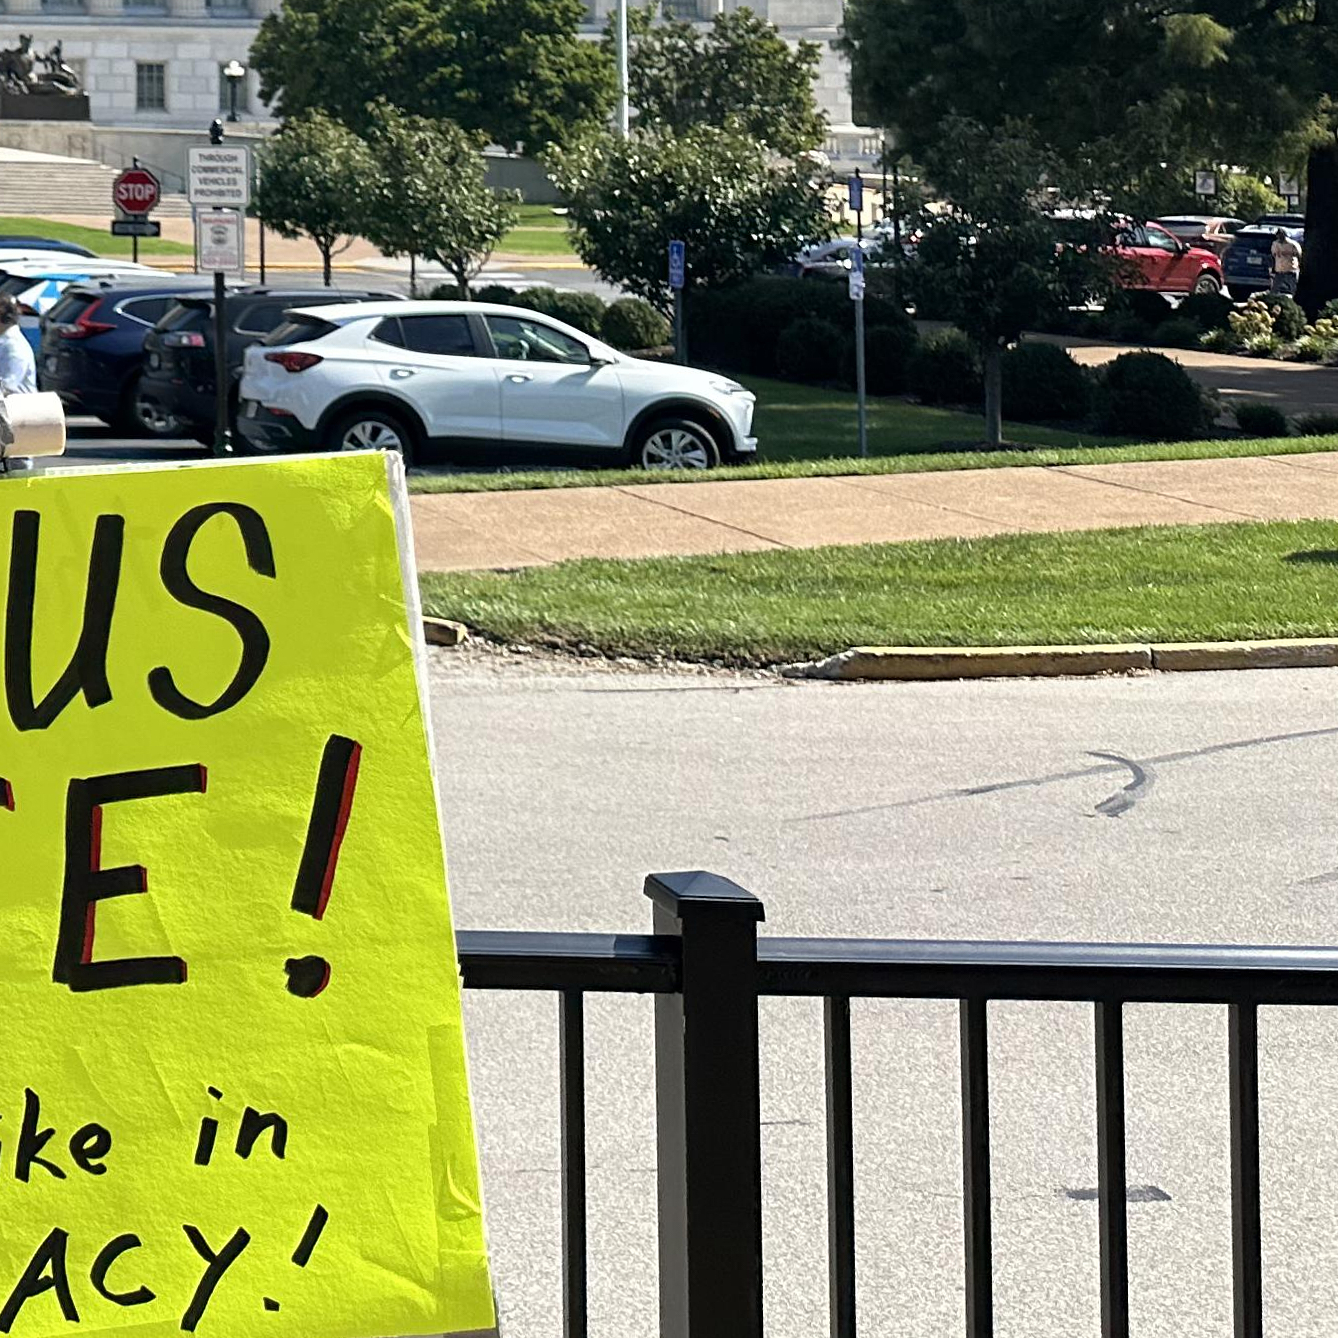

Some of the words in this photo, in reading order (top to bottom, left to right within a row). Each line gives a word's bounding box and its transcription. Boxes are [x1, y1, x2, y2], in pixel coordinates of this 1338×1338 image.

[198, 153, 238, 162] THROUGH
[191, 165, 243, 174] COMMERCIAL
[197, 177, 237, 186] VEHICLES
[117, 183, 155, 201] STOP
[194, 188, 243, 198] PROHIBITED
[4, 501, 277, 731] US
[194, 1085, 290, 1166] in
